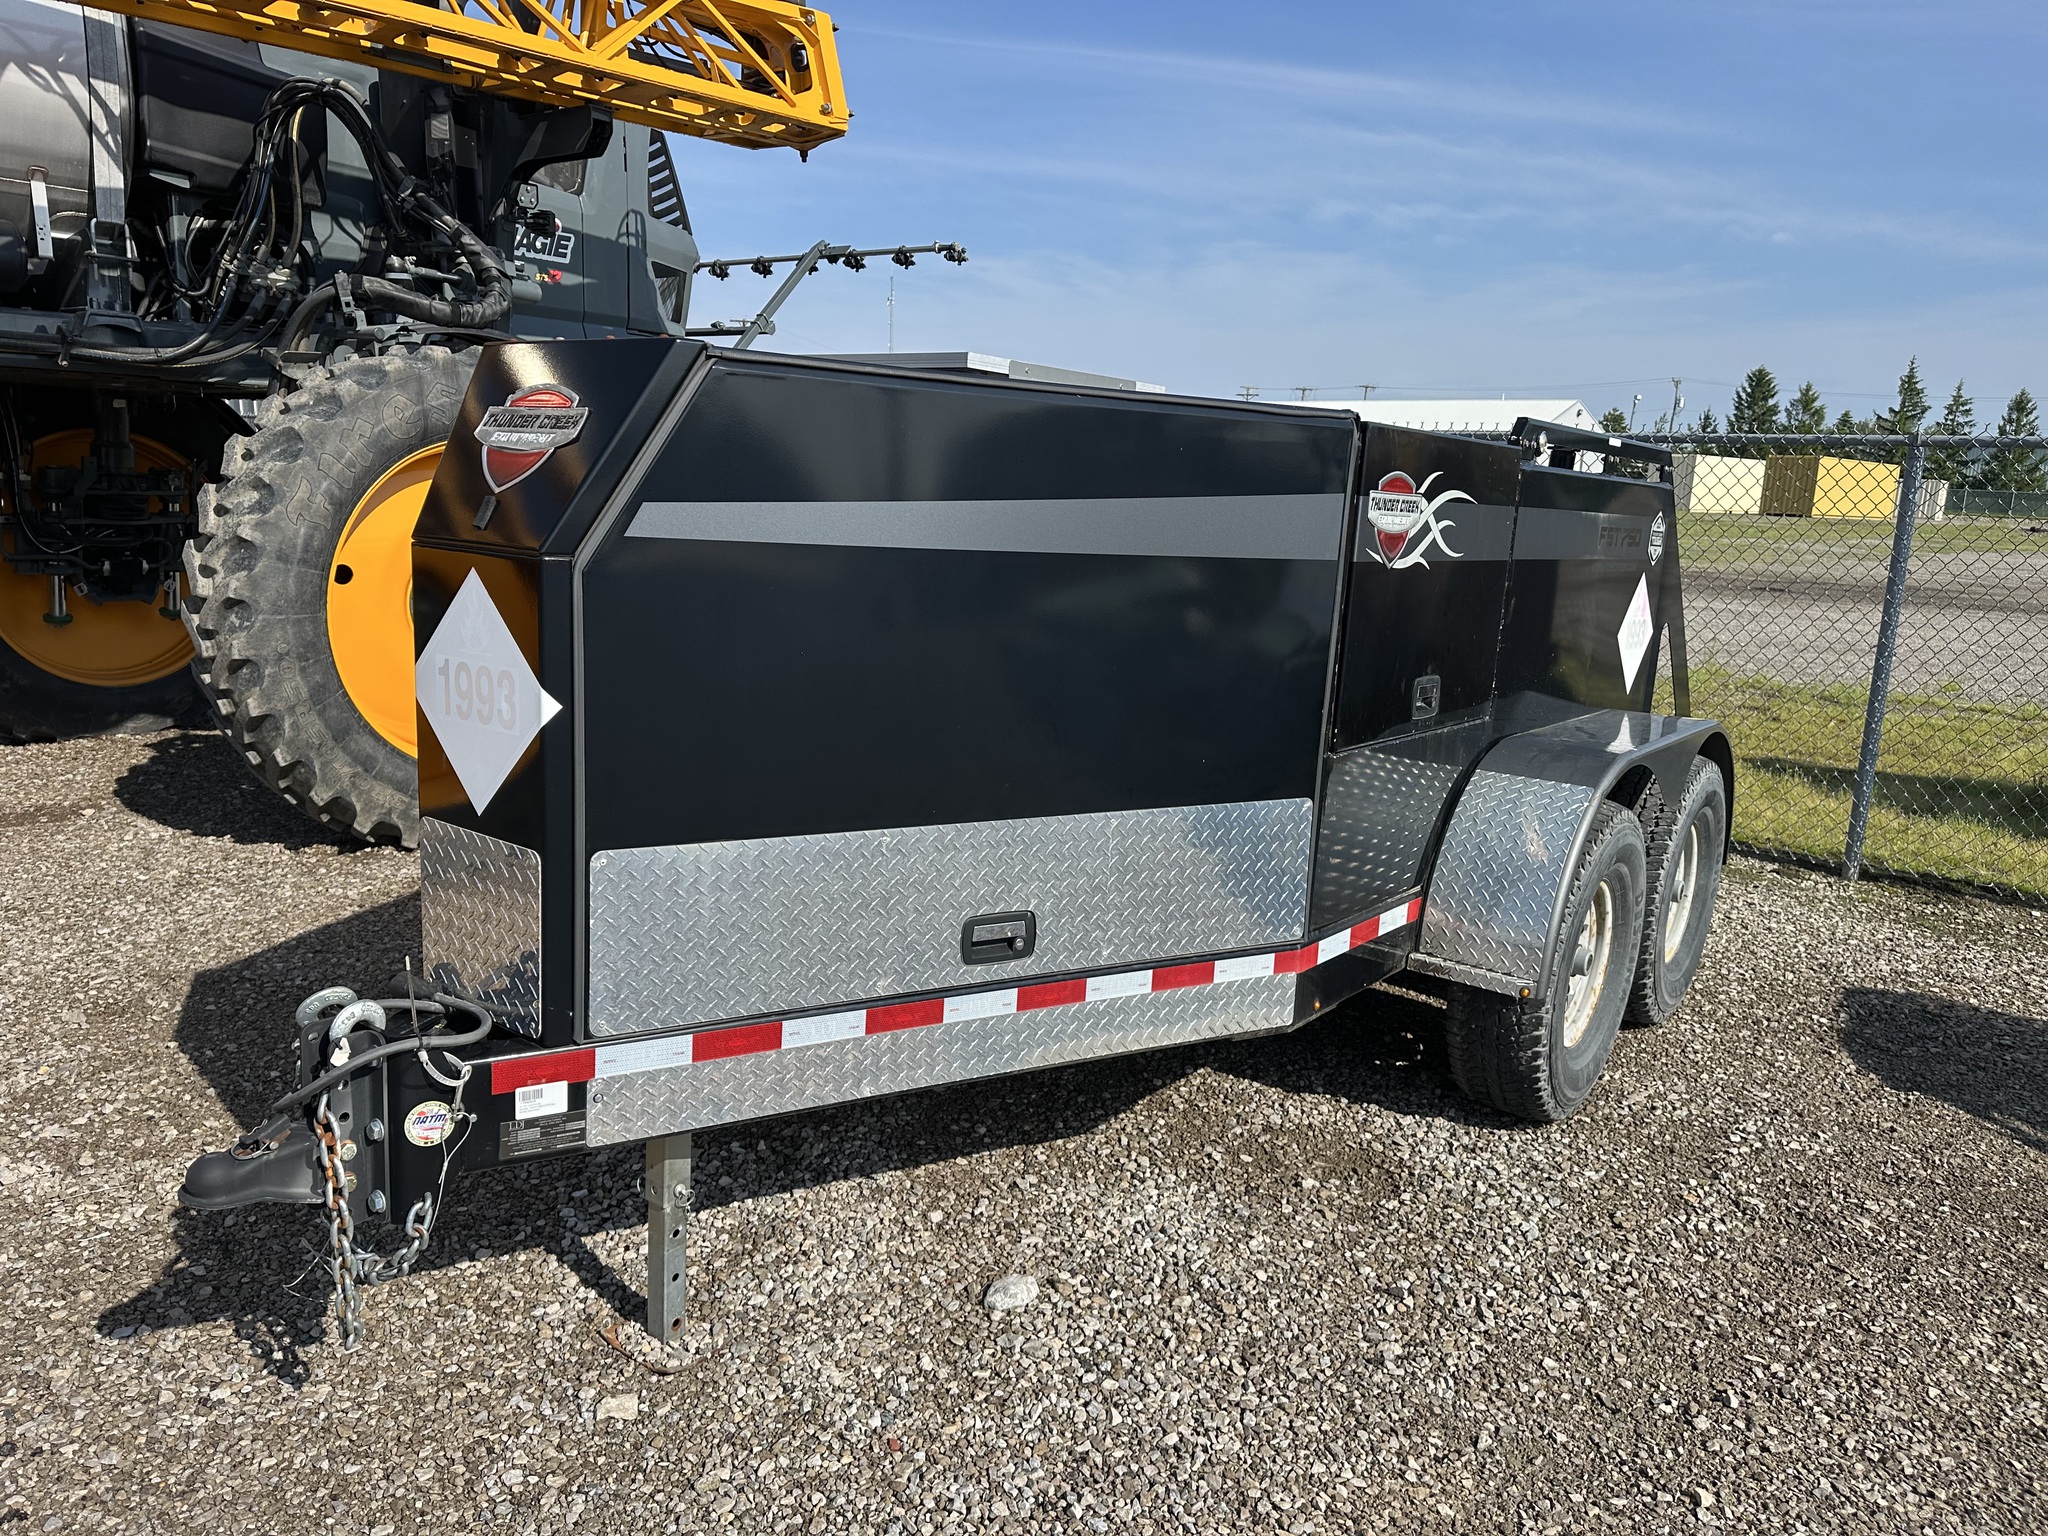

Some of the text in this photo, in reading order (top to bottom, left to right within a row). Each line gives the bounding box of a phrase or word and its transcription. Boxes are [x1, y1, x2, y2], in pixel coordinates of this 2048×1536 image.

[514, 223, 575, 263] AGIE
[483, 413, 583, 430] THUNDER CREEK
[1370, 496, 1420, 514] THUNDER CREEK
[1625, 618, 1647, 650] 1993
[437, 657, 517, 731] 1993
[412, 1113, 448, 1126] NATM
